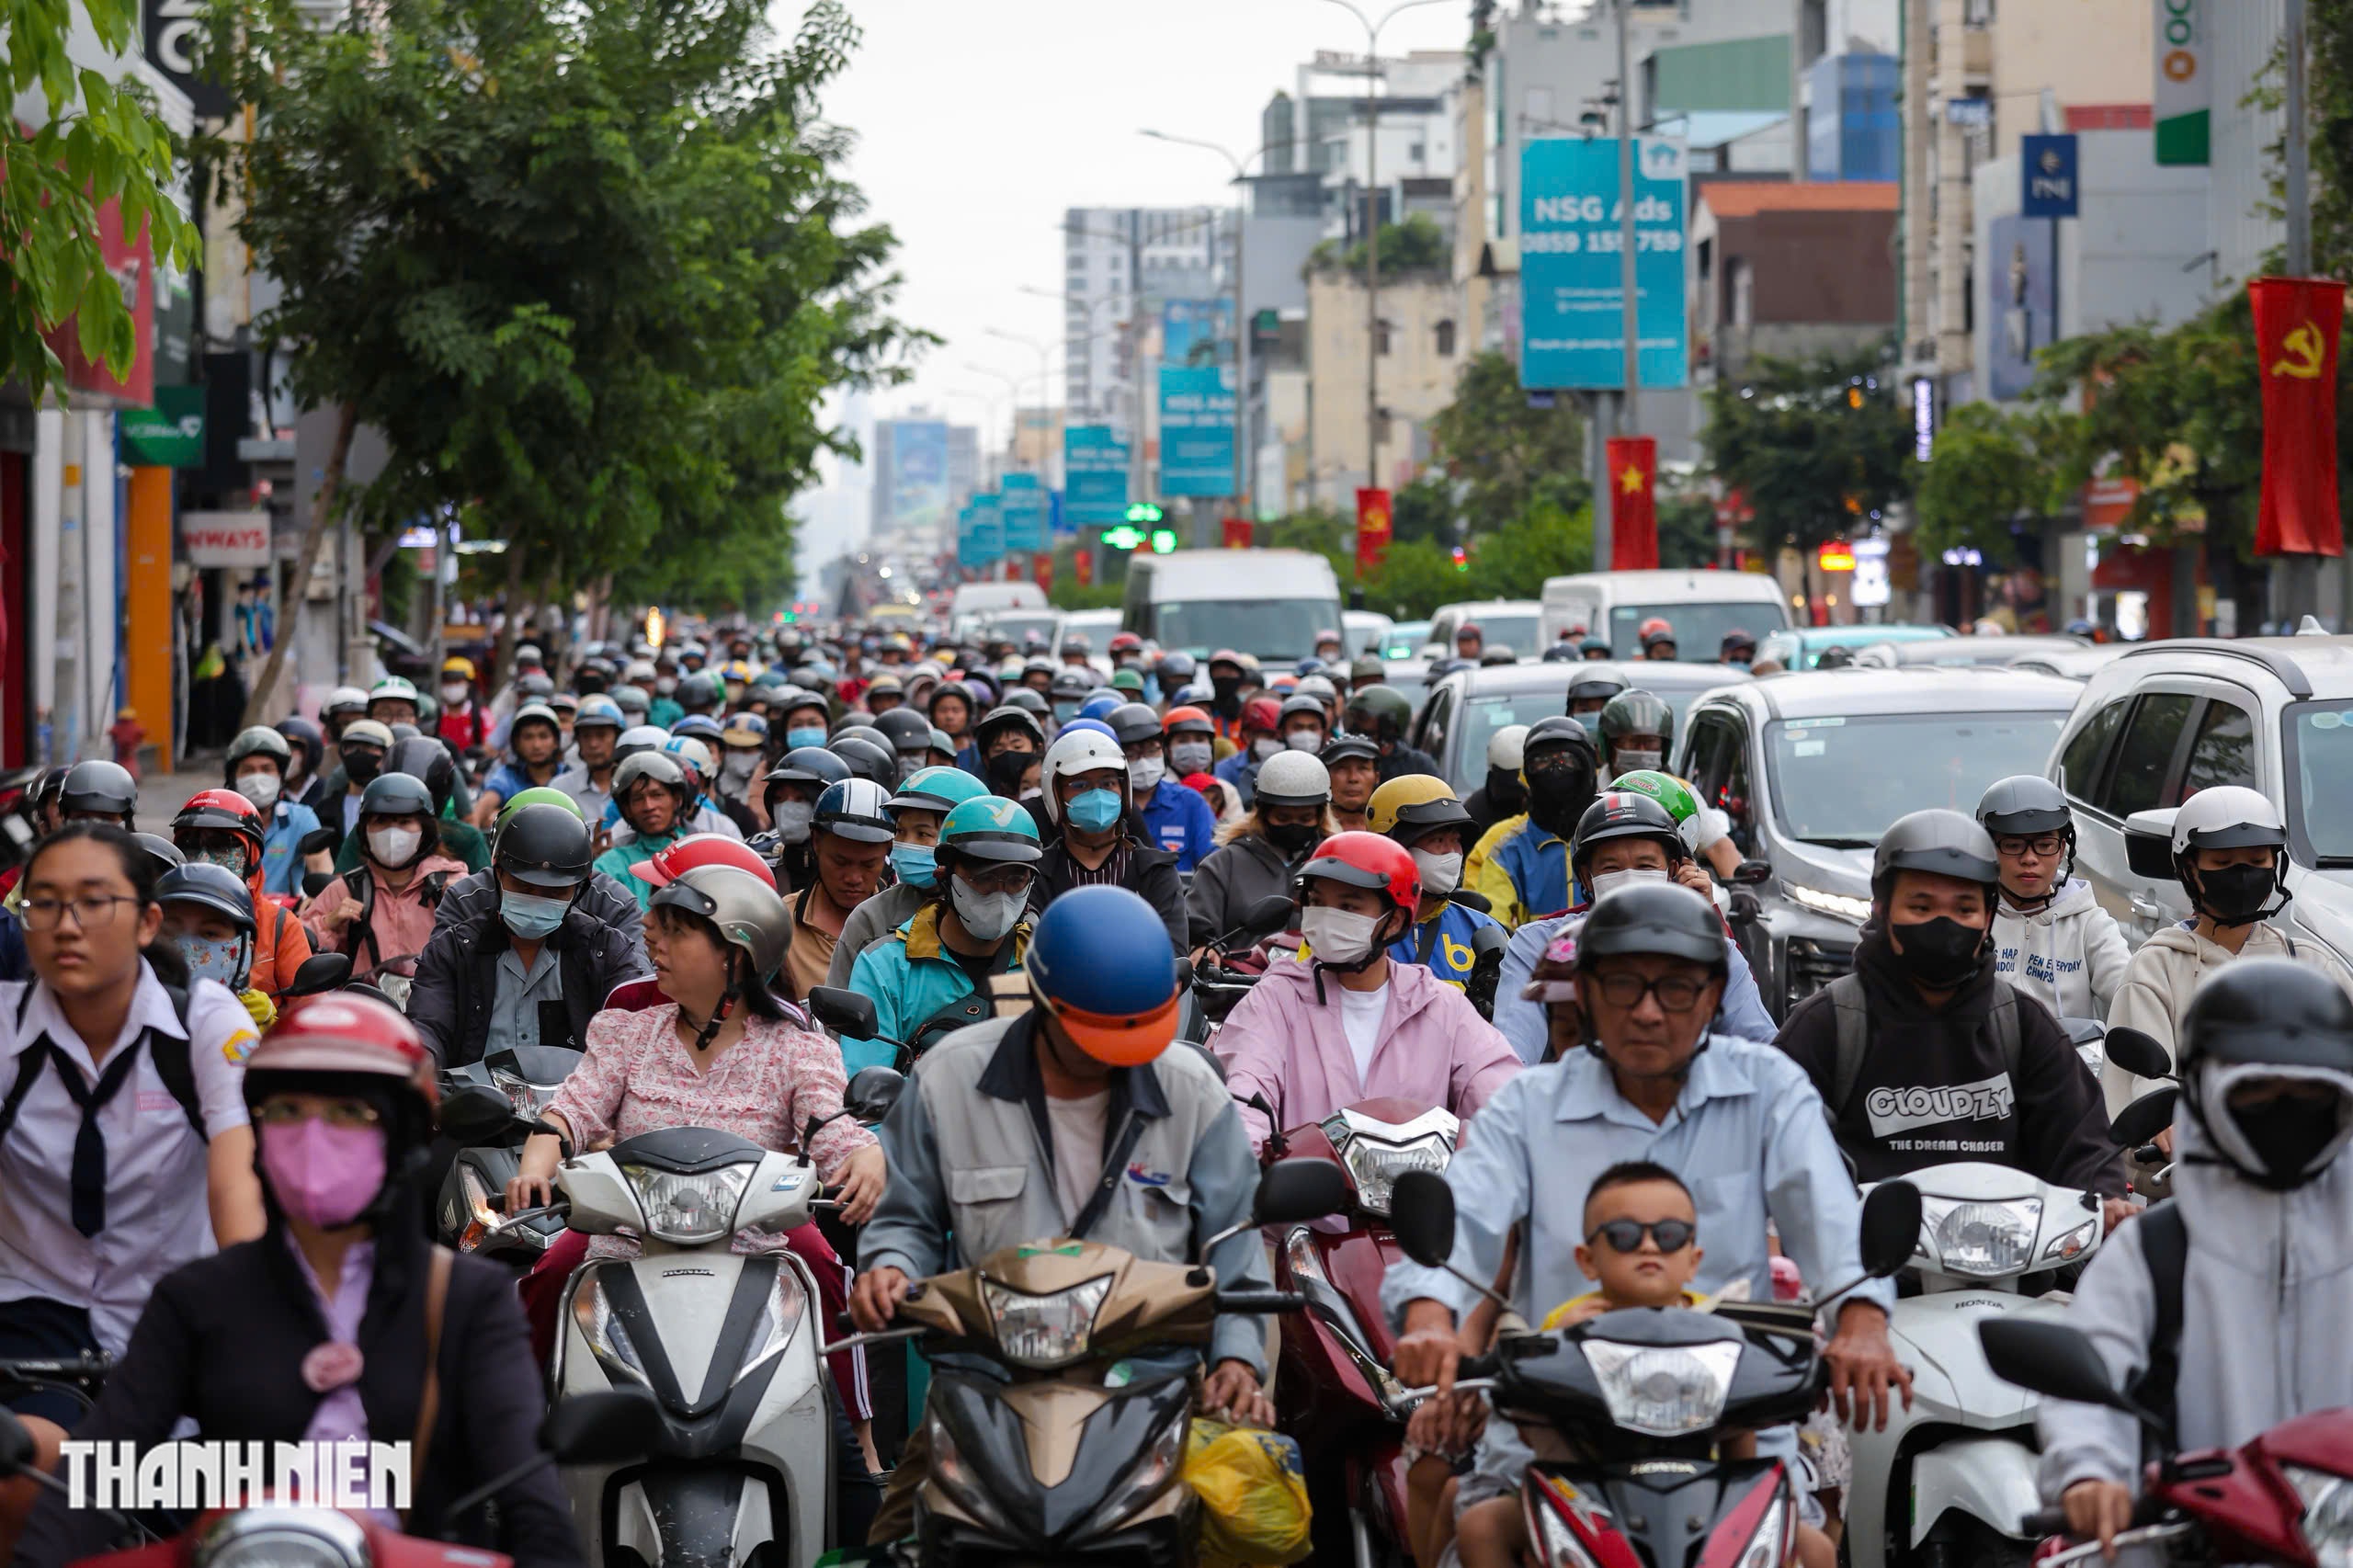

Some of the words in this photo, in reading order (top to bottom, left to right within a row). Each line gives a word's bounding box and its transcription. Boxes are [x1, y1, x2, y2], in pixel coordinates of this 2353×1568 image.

[1534, 196, 1604, 222] NSG
[2002, 948, 2018, 960] HAP
[2028, 953, 2045, 967] PEN
[2046, 959, 2082, 972] EERYDAY
[1869, 1086, 2008, 1119] CLOUDZY
[1889, 1140, 1913, 1151] THE
[1915, 1140, 1958, 1152] DREAM
[1960, 1141, 2005, 1153] CHASER
[663, 1268, 715, 1278] HONDA
[1954, 1297, 2005, 1310] HONDA
[1630, 1461, 1698, 1476] HONDA
